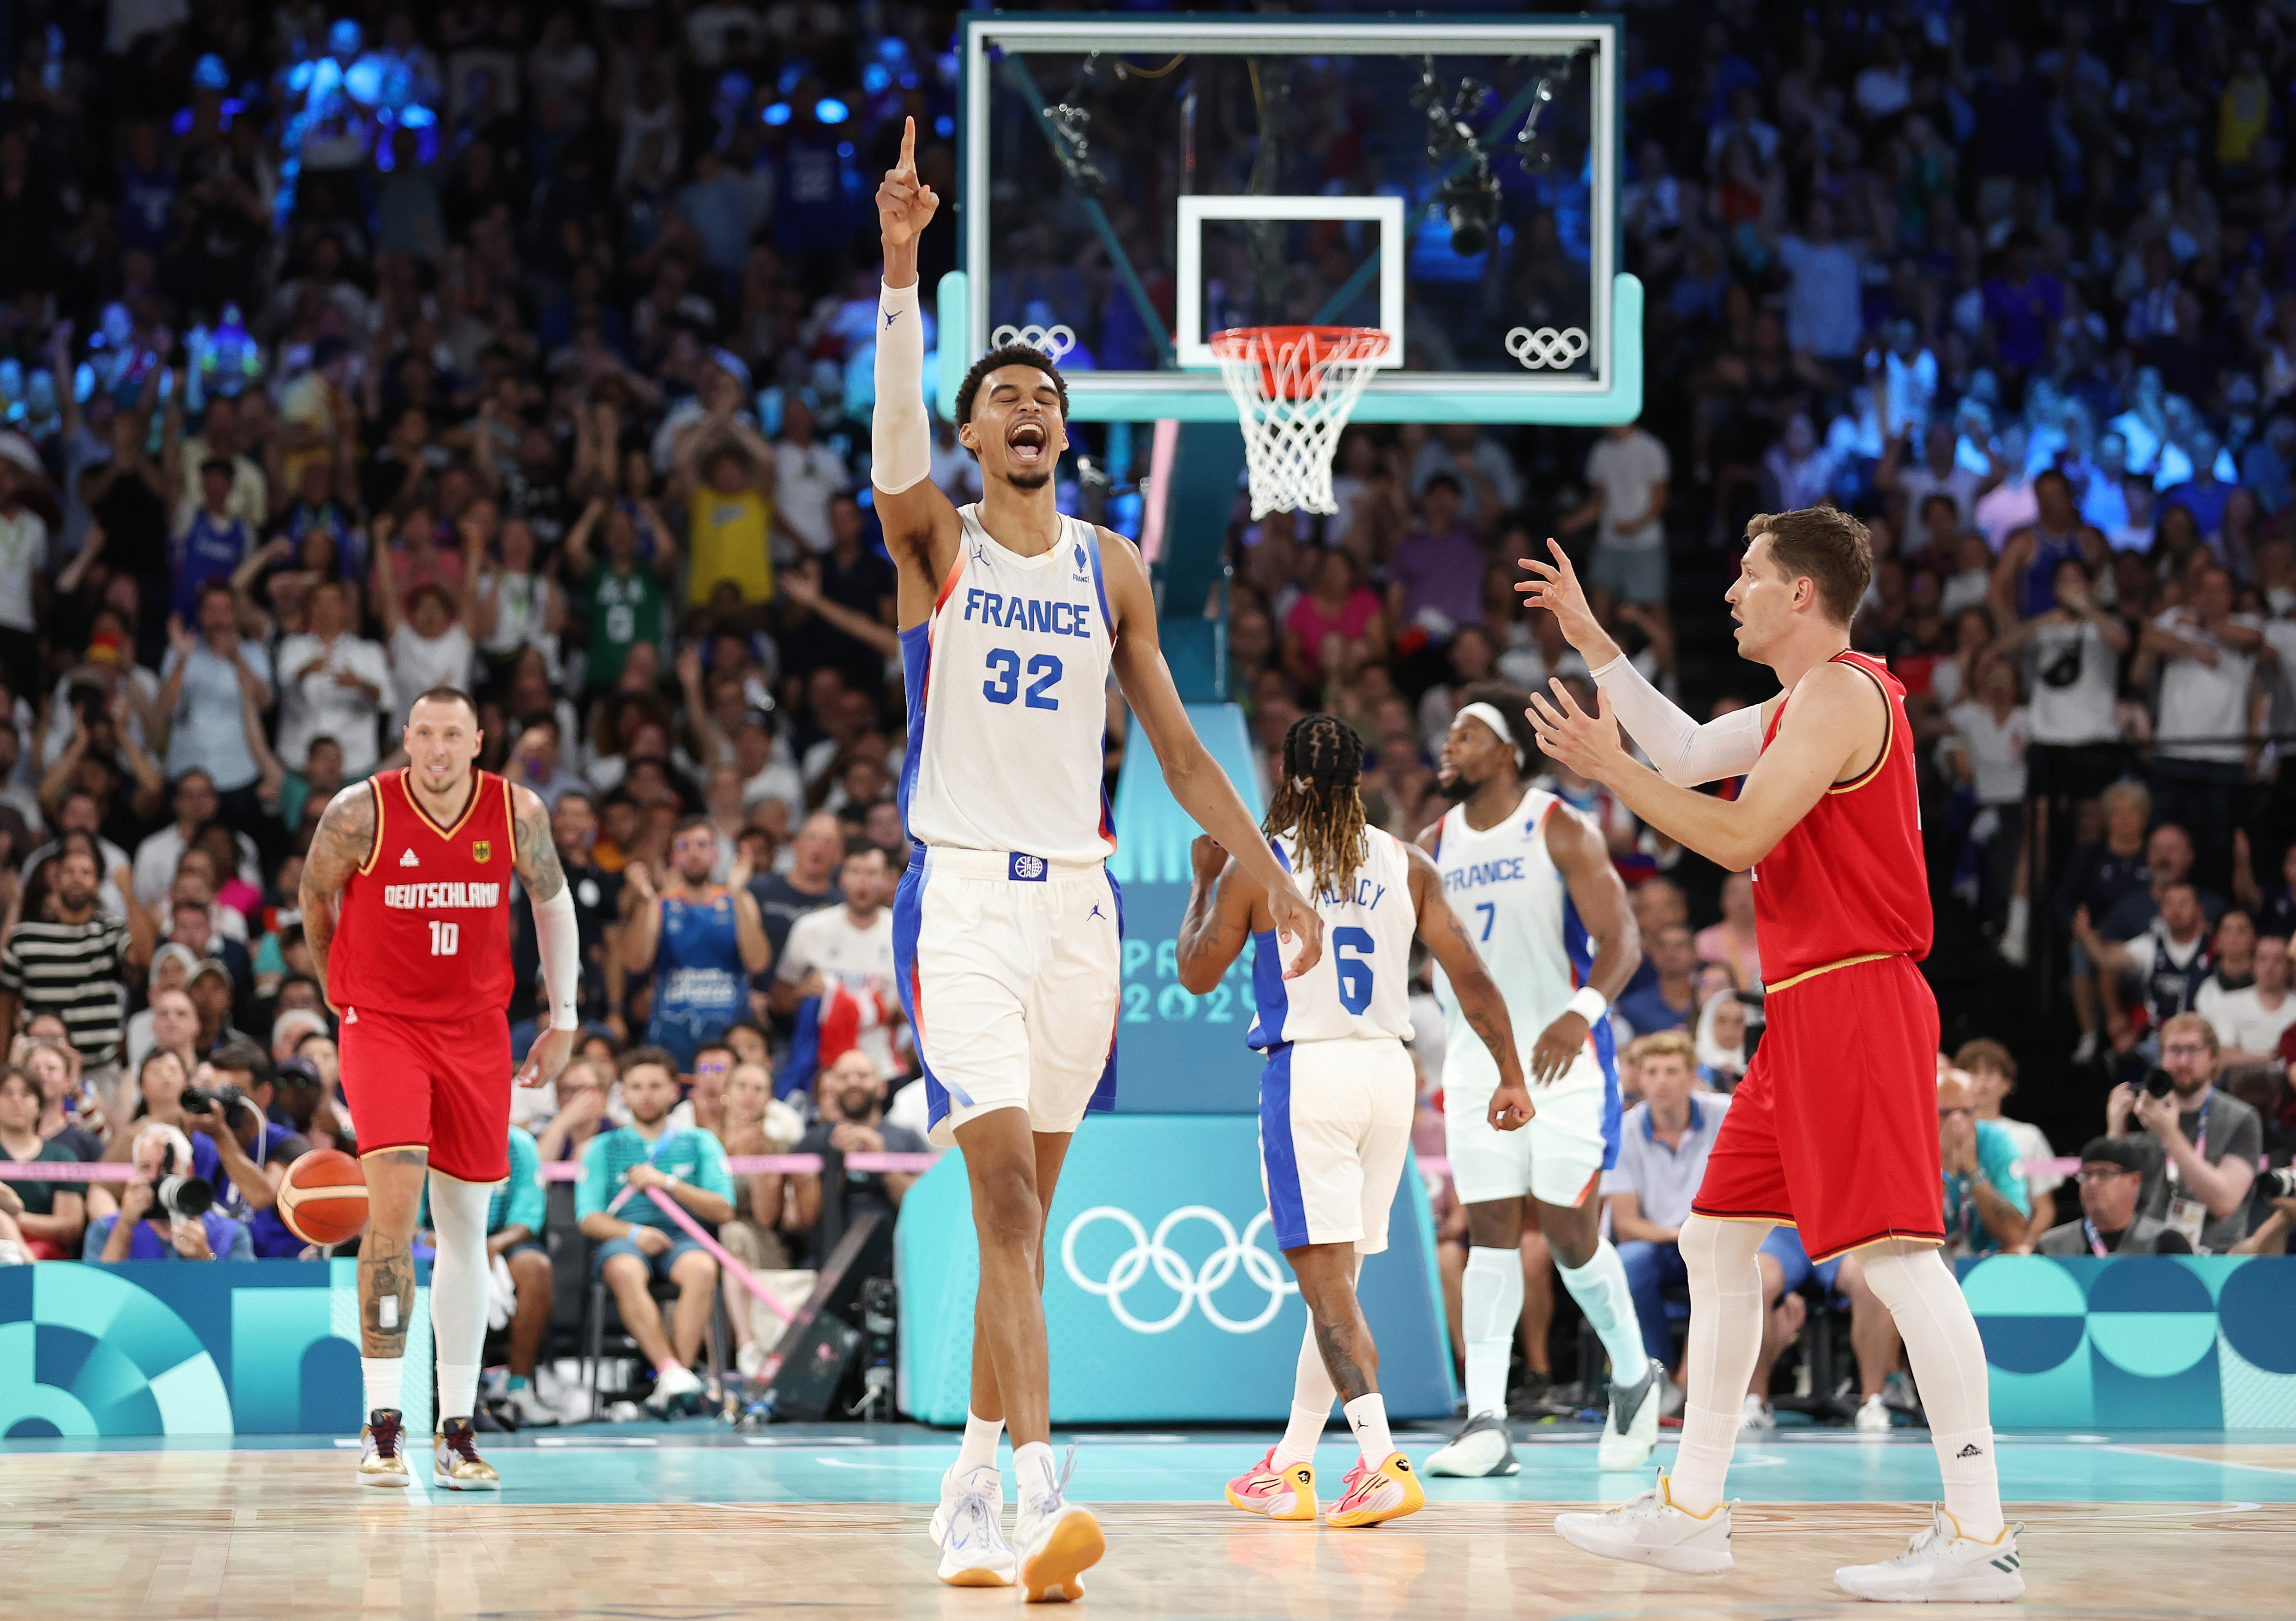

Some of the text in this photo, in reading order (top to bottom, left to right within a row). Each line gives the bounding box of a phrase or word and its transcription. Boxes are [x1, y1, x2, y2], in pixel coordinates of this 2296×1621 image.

[1073, 573, 1090, 583] FRANCE
[964, 588, 1091, 638] FRANCE
[982, 648, 1063, 711] 32
[1444, 856, 1525, 891] FRANCE
[384, 882, 500, 910] DEUTSCHLAND
[428, 920, 460, 956] 10
[1476, 902, 1495, 942] 7
[1332, 926, 1375, 1015] 6
